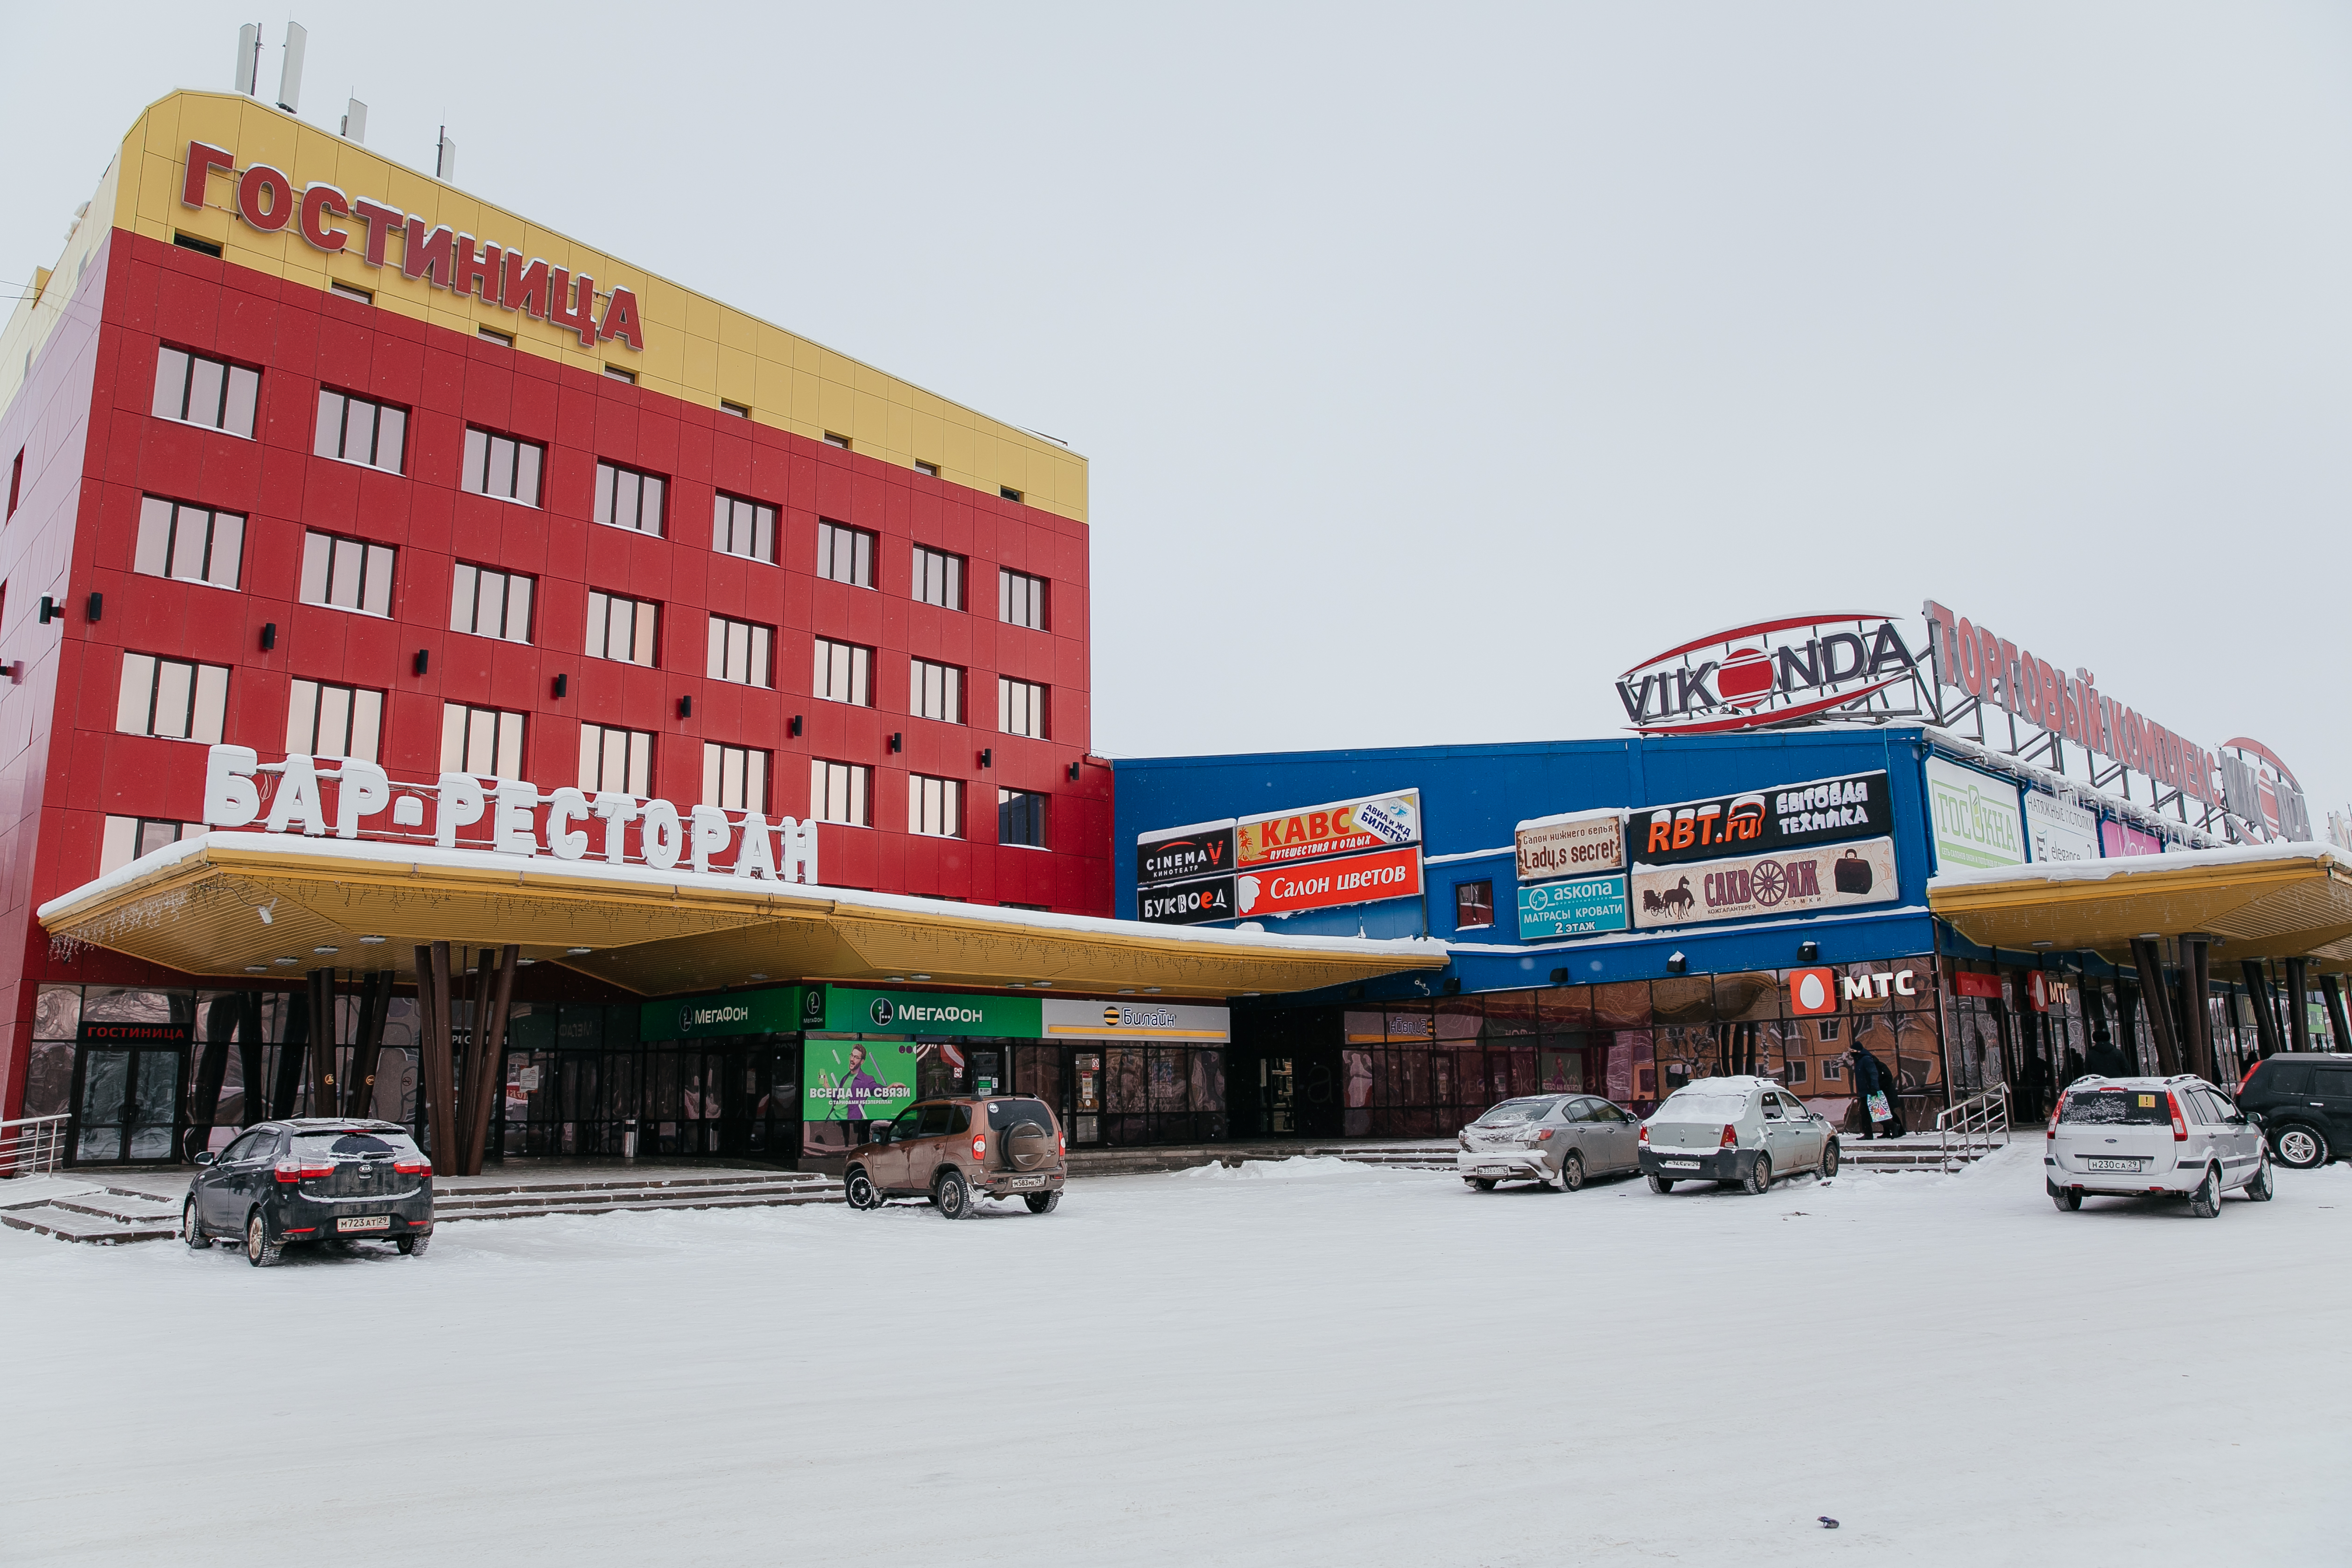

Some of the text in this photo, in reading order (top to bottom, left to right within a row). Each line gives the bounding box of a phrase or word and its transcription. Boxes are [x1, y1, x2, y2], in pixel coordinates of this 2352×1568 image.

[181, 140, 644, 351] ГОСТИНИЦА
[1615, 623, 1919, 723] VIKONDA
[1924, 598, 2221, 808] ТОРГОВЫЙ КОМПЛЕКС
[1776, 782, 1868, 814] БЫТОВАЯ
[2027, 796, 2065, 821] НАТЯЖНЫЕ
[1261, 807, 1350, 848] КАВС
[1361, 812, 1407, 842] БИЛЕТЫ
[1366, 804, 1388, 822] АВИА
[1395, 822, 1411, 837] ЖД
[1648, 804, 1765, 853] RBT.ru
[1779, 805, 1869, 834] ТЕХНИКА
[1938, 784, 2017, 853] ГОСОКНА
[1270, 835, 1371, 860] ПУТЕШЕСТВИЯ И ОТДЫХ
[1523, 825, 1613, 845] Салон нижнего белья
[1571, 839, 1615, 863] secret
[1942, 847, 1950, 856] СЕТЬ
[2051, 841, 2080, 861] elegance
[1154, 865, 1198, 877] КИНОТЕАТР
[1270, 866, 1406, 899] Салон цветов
[1554, 882, 1612, 901] askona
[1524, 904, 1622, 924] МАТРАСЫ КРОВАТИ
[1708, 904, 1756, 914] КОЖГАЛАНТЕРЕЯ
[1555, 922, 1563, 933] 2
[1844, 970, 1917, 1000] МТС
[2049, 981, 2071, 1004] МТС
[1123, 1008, 1175, 1027] Билайн
[88, 1027, 184, 1040] ГОСТИНИЦА
[810, 1087, 910, 1099] ВСЕГДА НА СВЯЗИ
